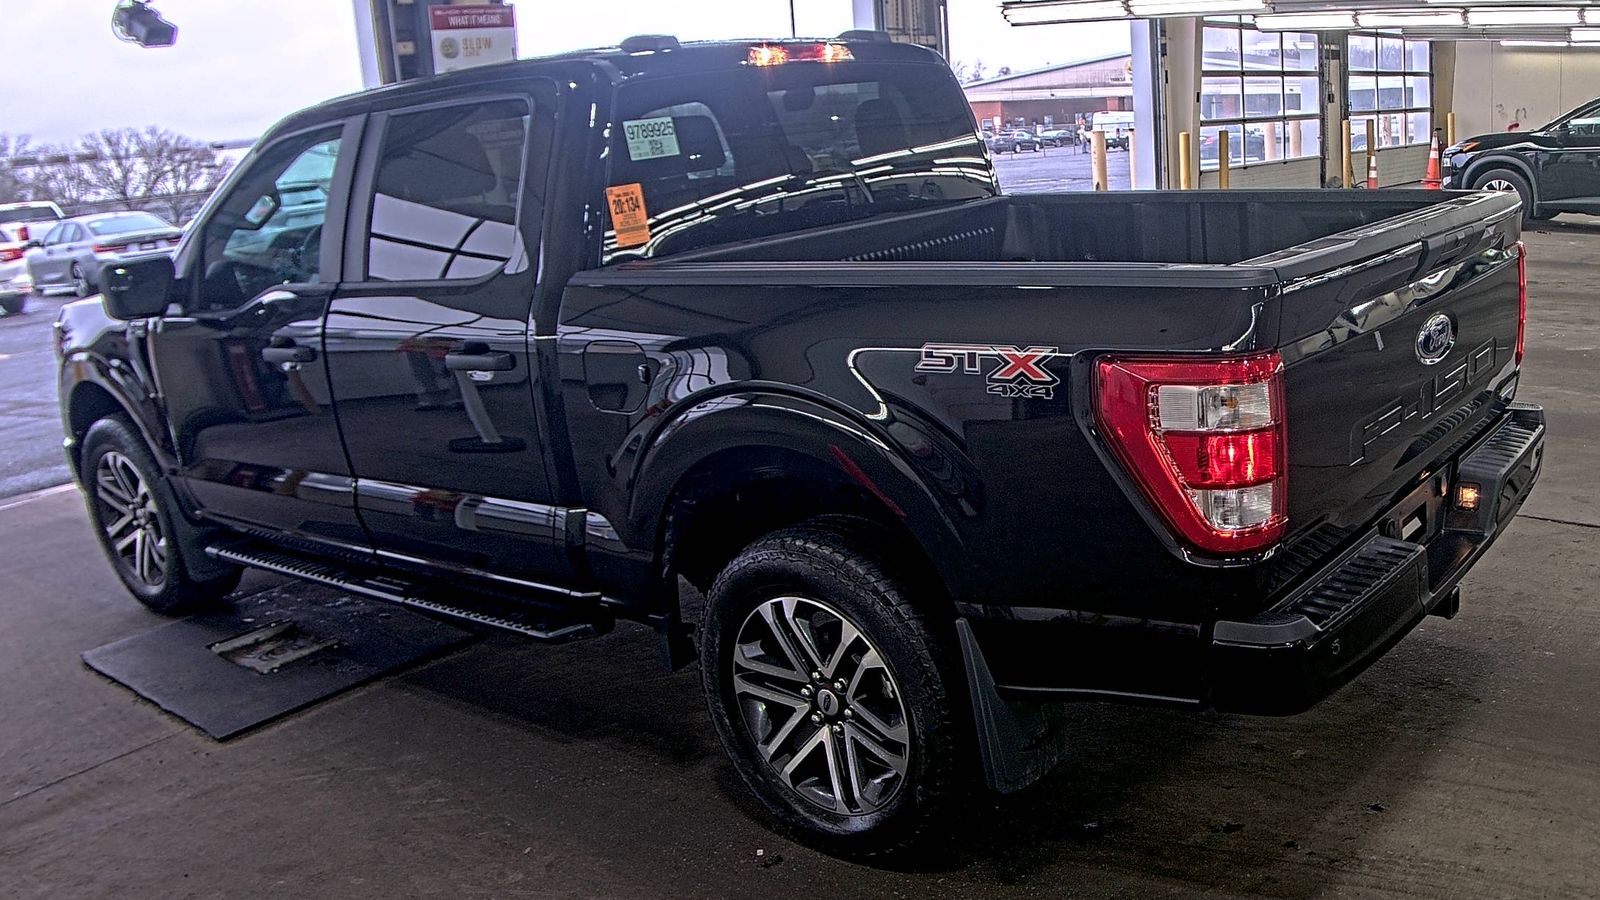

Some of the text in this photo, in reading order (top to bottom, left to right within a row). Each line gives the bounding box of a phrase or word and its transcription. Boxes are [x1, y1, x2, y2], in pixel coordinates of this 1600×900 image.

[448, 15, 468, 27] WHAT
[914, 342, 1060, 385] STX
[1349, 336, 1497, 467] F-150
